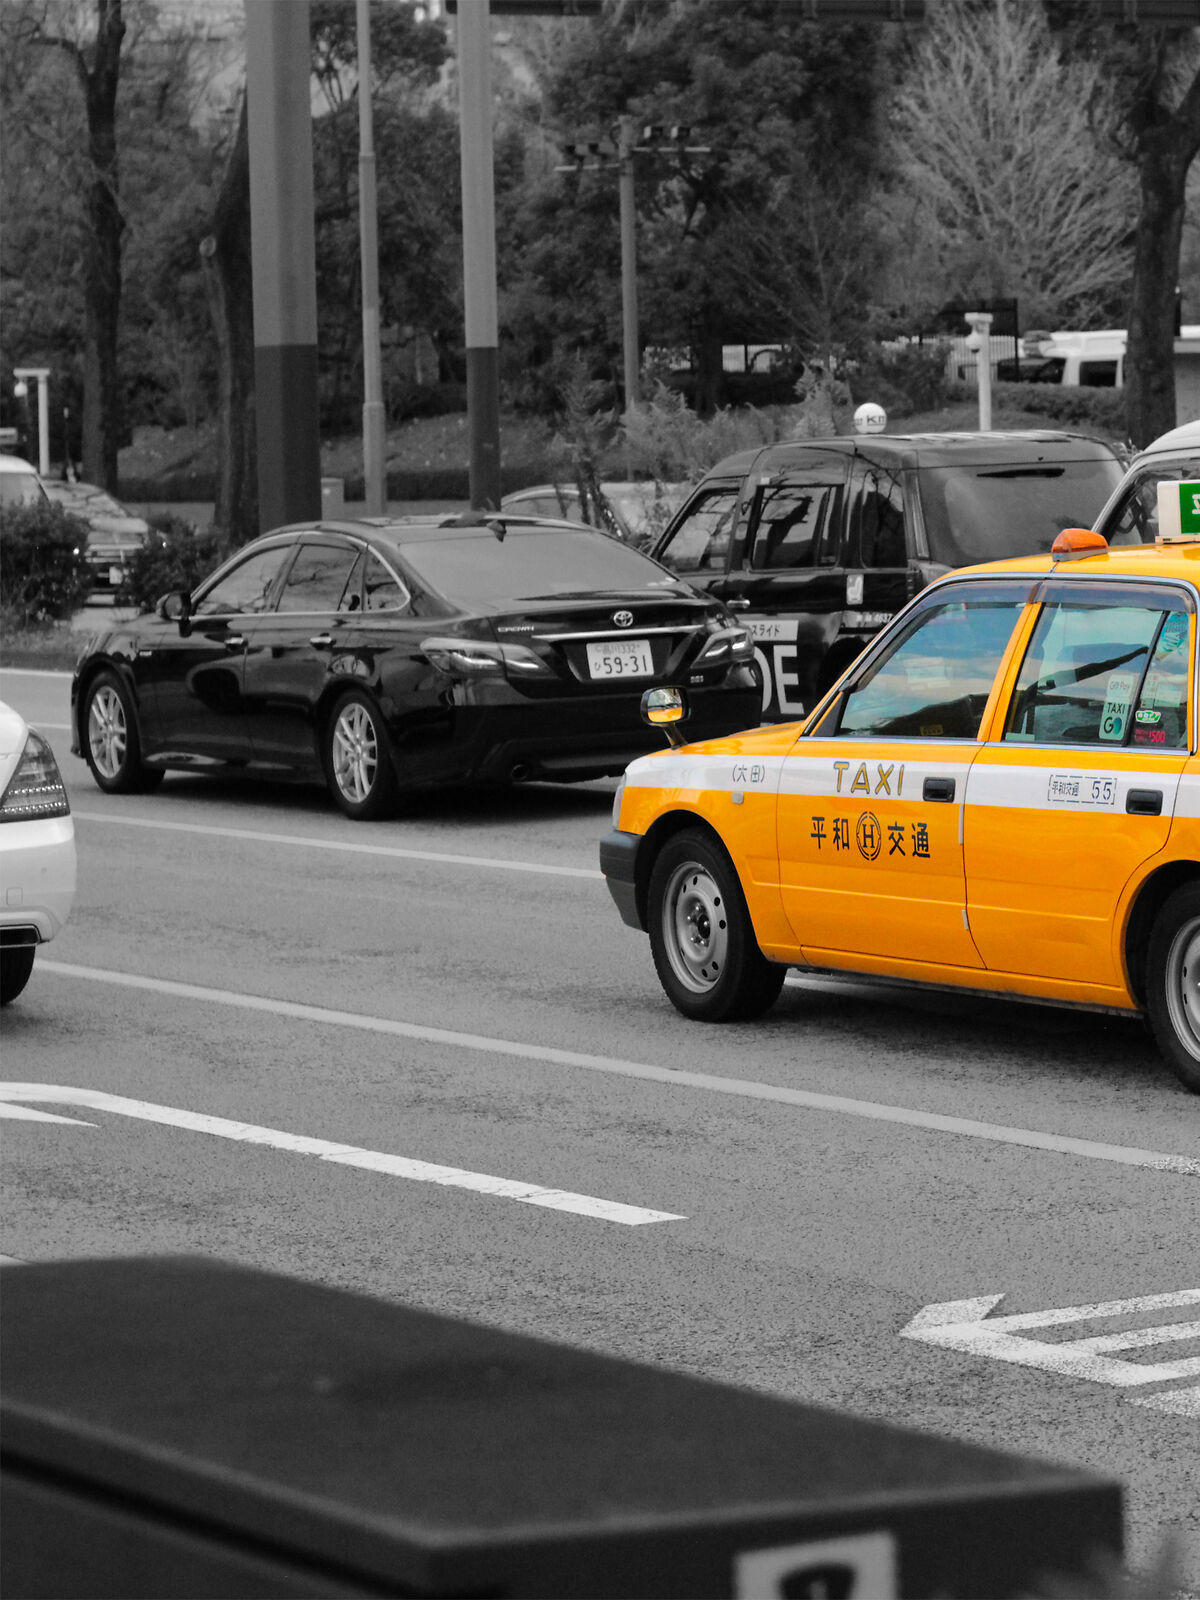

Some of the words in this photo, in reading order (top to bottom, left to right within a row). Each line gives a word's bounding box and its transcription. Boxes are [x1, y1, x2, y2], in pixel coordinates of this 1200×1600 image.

[603, 654, 647, 674] 59-31
[1107, 702, 1126, 714] TAXI
[833, 761, 905, 796] TAXI
[1091, 780, 1113, 800] 55
[811, 816, 850, 851] 平和
[887, 821, 931, 859] 交通
